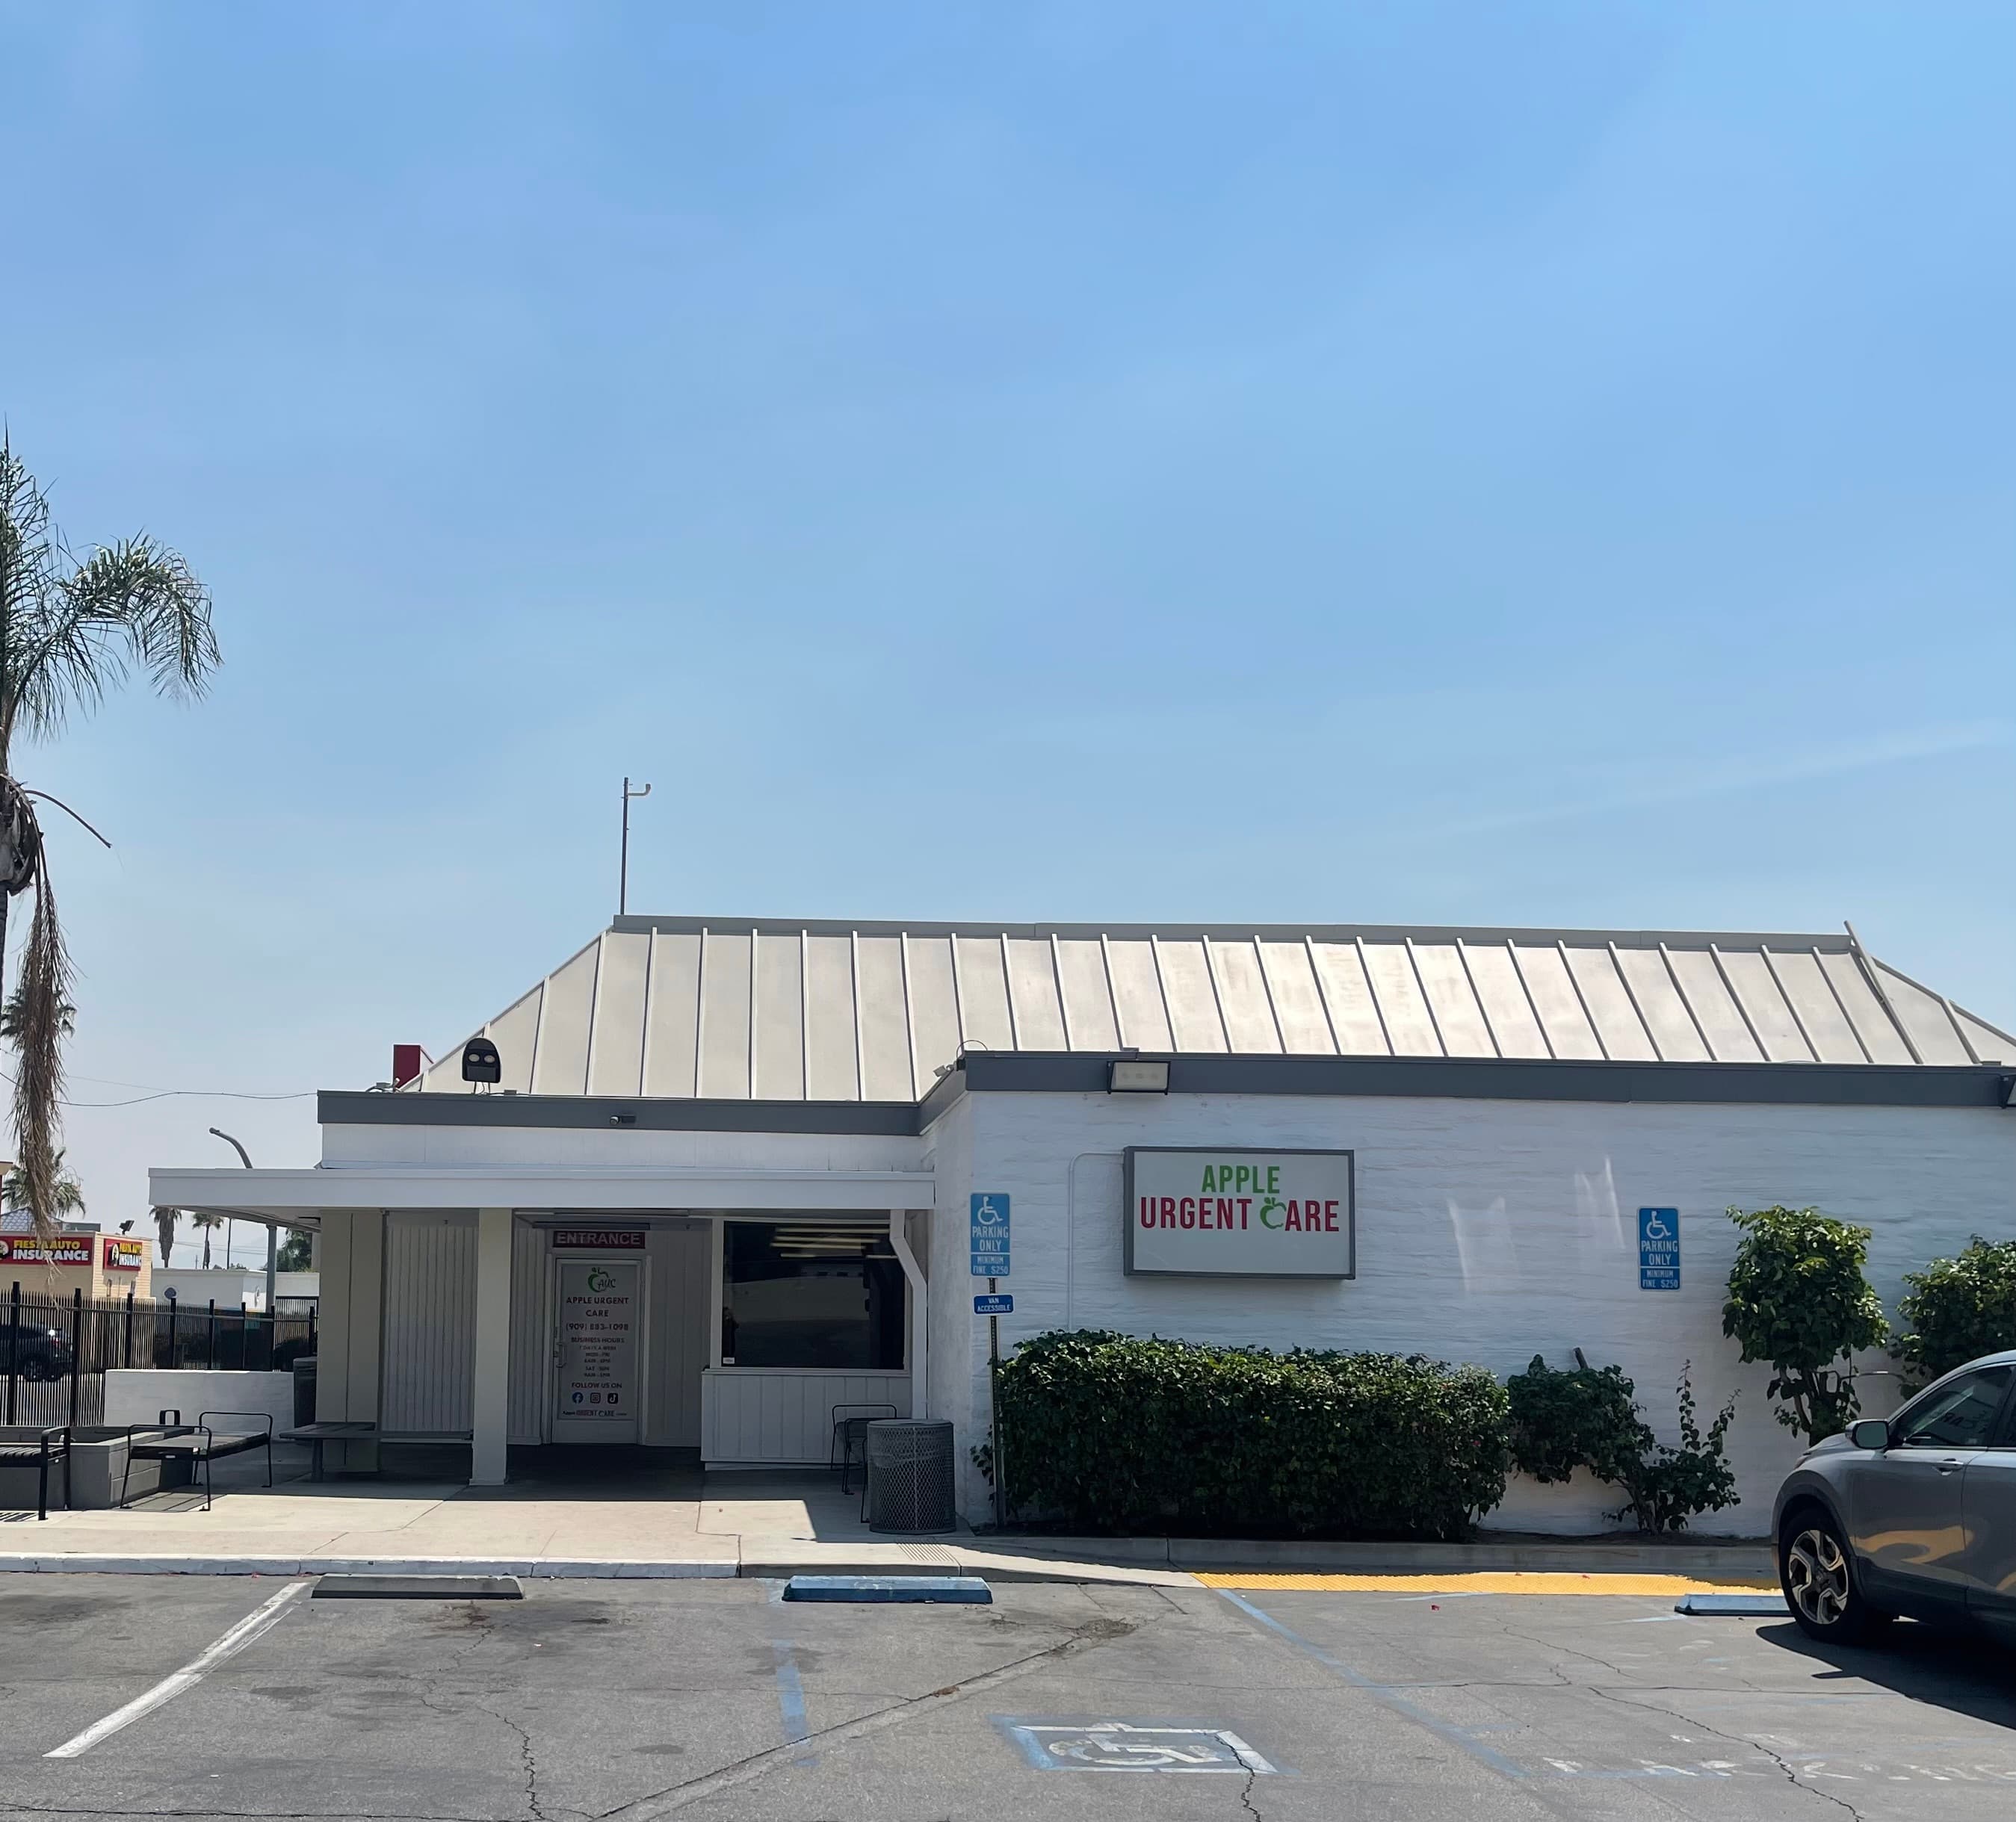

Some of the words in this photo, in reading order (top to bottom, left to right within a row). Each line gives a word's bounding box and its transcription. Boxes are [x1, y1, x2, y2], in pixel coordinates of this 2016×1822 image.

[1202, 1165, 1280, 1194] APPLE
[1140, 1197, 1252, 1230] URGENT
[1260, 1197, 1339, 1232] CARE
[972, 1226, 1009, 1238] PARKING
[557, 1232, 640, 1245] ENTRANCE
[50, 1240, 81, 1250] AUTO
[979, 1240, 1002, 1251] ONLY
[1641, 1240, 1678, 1252] PARKING
[13, 1249, 89, 1261] INSURANCE
[977, 1256, 1004, 1264] MINIMUM
[1648, 1254, 1672, 1265] ONLY
[973, 1265, 986, 1274] FINE
[1647, 1269, 1674, 1277] MINIMUM
[1642, 1279, 1657, 1288] FINE
[1660, 1279, 1678, 1288] $250
[566, 1296, 592, 1304] APPLE
[594, 1296, 629, 1304] URGENT
[586, 1309, 609, 1317] CARE
[977, 1304, 1011, 1313] ACCESSIBLE
[566, 1322, 587, 1331] (909)
